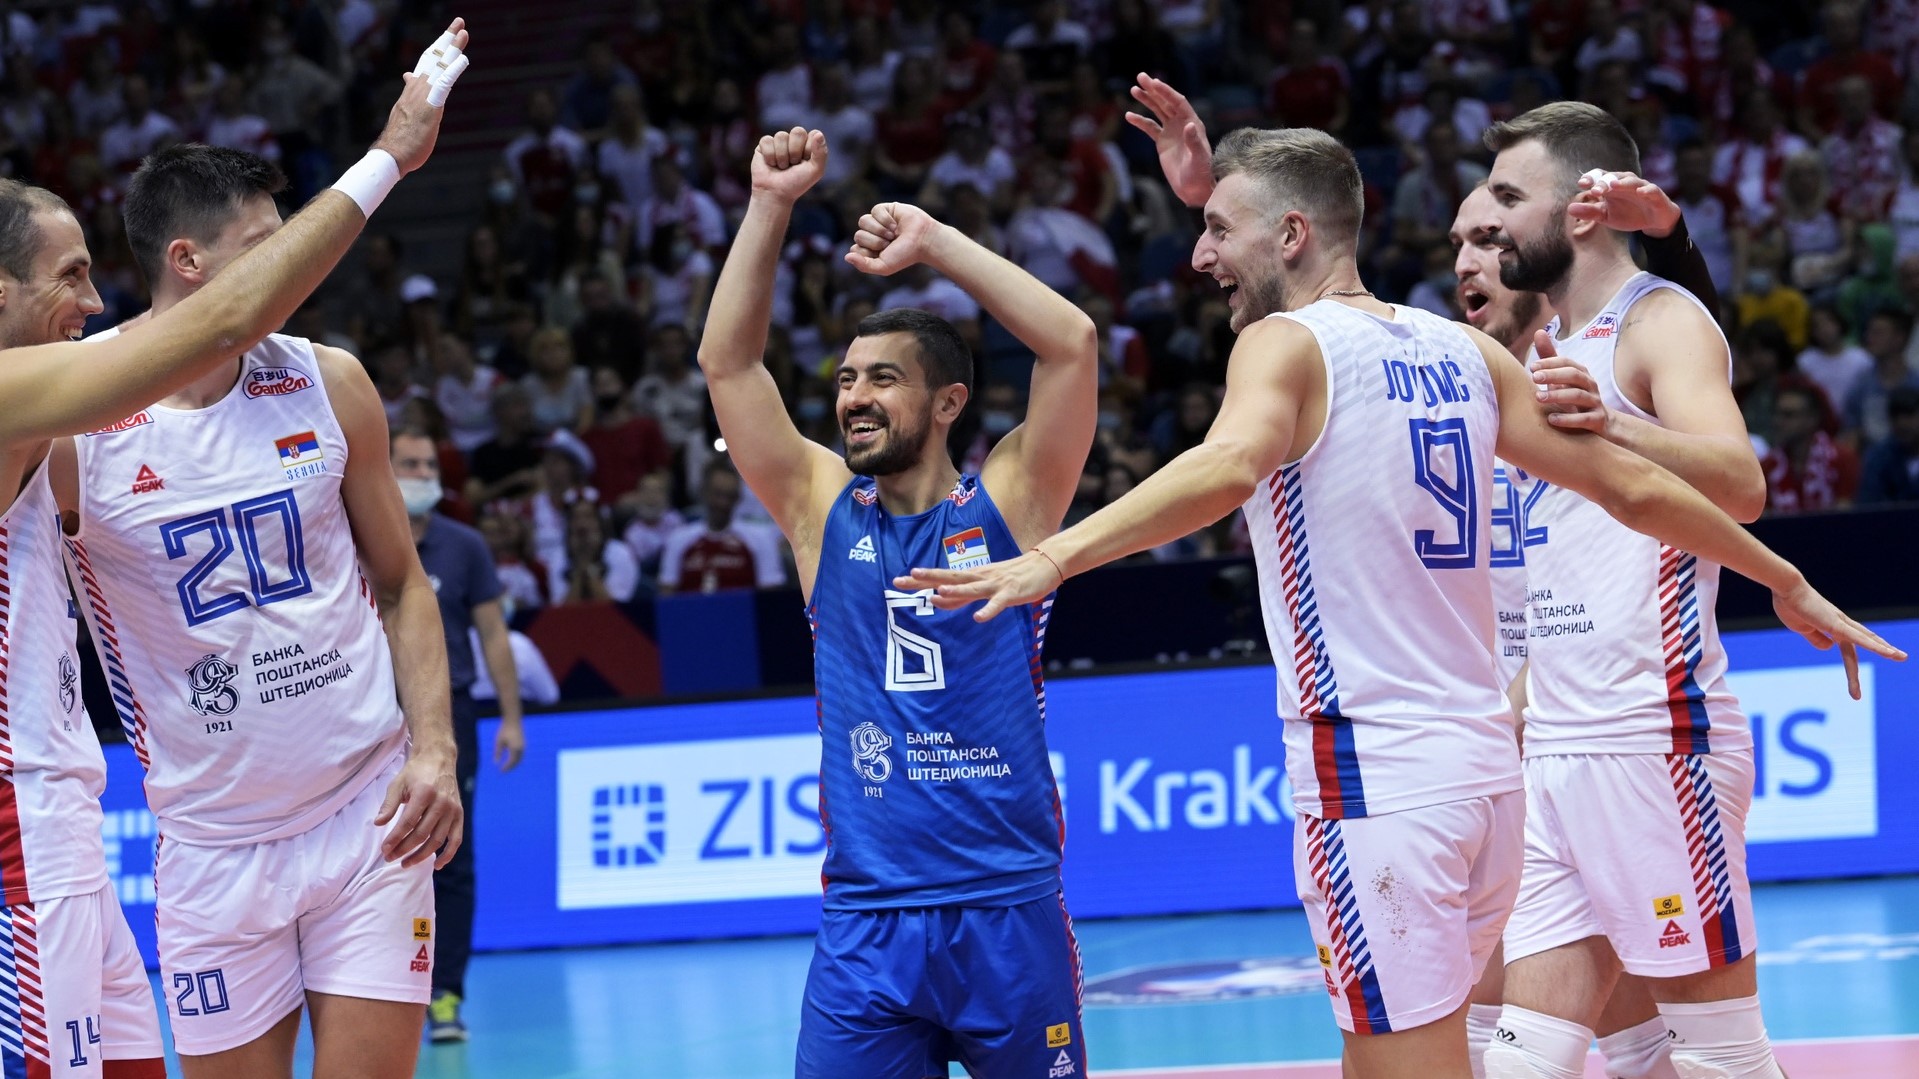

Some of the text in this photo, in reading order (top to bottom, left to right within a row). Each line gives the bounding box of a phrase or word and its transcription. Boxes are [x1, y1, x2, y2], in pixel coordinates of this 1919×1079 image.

[252, 369, 288, 382] 百岁山
[286, 461, 327, 481] SERBIA
[132, 478, 165, 495] PEAK
[1409, 417, 1477, 569] 9
[159, 488, 313, 627] 20
[848, 548, 877, 563] PEAK
[1525, 589, 1552, 603] АНКА
[1499, 611, 1527, 623] БАНК
[884, 588, 945, 691] 6
[1501, 628, 1527, 640] ПОШ
[252, 643, 305, 667] БАНКА
[256, 648, 342, 685] ПОШТАНСКА
[260, 663, 353, 704] ШТЕДИОНИЦА
[205, 720, 234, 734] 1921
[906, 732, 954, 745] БАНКА
[907, 747, 999, 763] ПОШТАНСКА
[1752, 710, 1832, 797] IS
[908, 763, 1012, 782] ШТЕДИОНИЦА
[863, 786, 883, 798] 1921
[699, 774, 828, 859] ZIS
[1657, 907, 1681, 916] MOZZART
[1659, 932, 1691, 948] PEAK
[410, 960, 430, 972] PEAK
[174, 968, 230, 1017] 20
[66, 1014, 102, 1067] 14
[1049, 1062, 1075, 1078] PEAK
